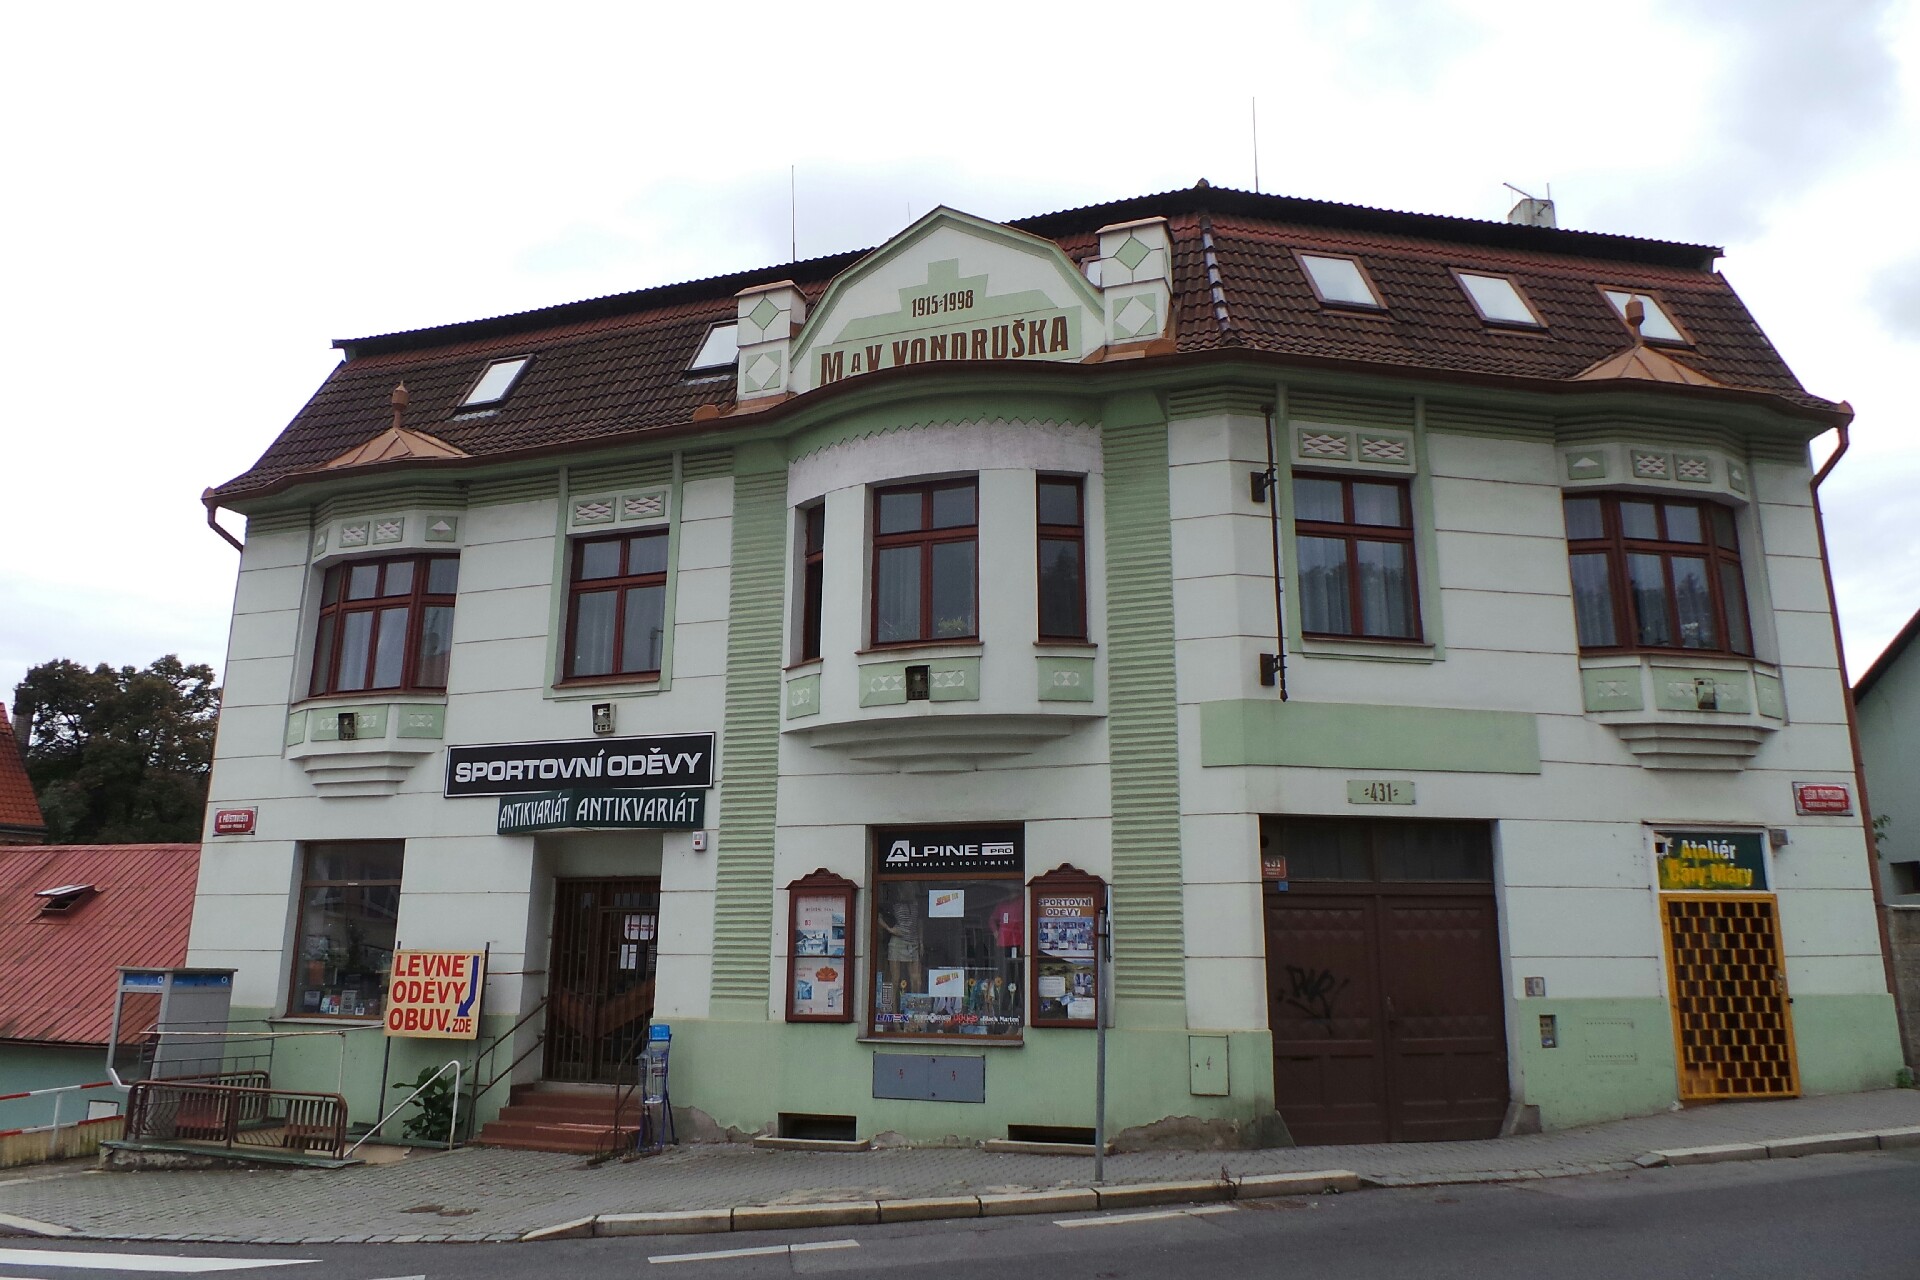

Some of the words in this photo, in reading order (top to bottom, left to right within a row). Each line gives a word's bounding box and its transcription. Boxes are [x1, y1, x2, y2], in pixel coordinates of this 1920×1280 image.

[892, 316, 1069, 366] VONDRUŠKA
[455, 748, 605, 783] SPORTOVNÍ
[607, 747, 703, 777] ODĚVY
[500, 792, 570, 829] ANTIKVARIÁT
[576, 792, 700, 823] ANTIKVARIÁT
[886, 840, 979, 862] ALPINE
[1681, 839, 1736, 859] Ateliér
[1710, 862, 1752, 887] Máry
[1038, 897, 1091, 906] SPORTOVNÍ
[395, 955, 470, 977] LEVNÉ
[392, 977, 467, 1004] ODĚVY
[451, 1018, 472, 1033] ZDE
